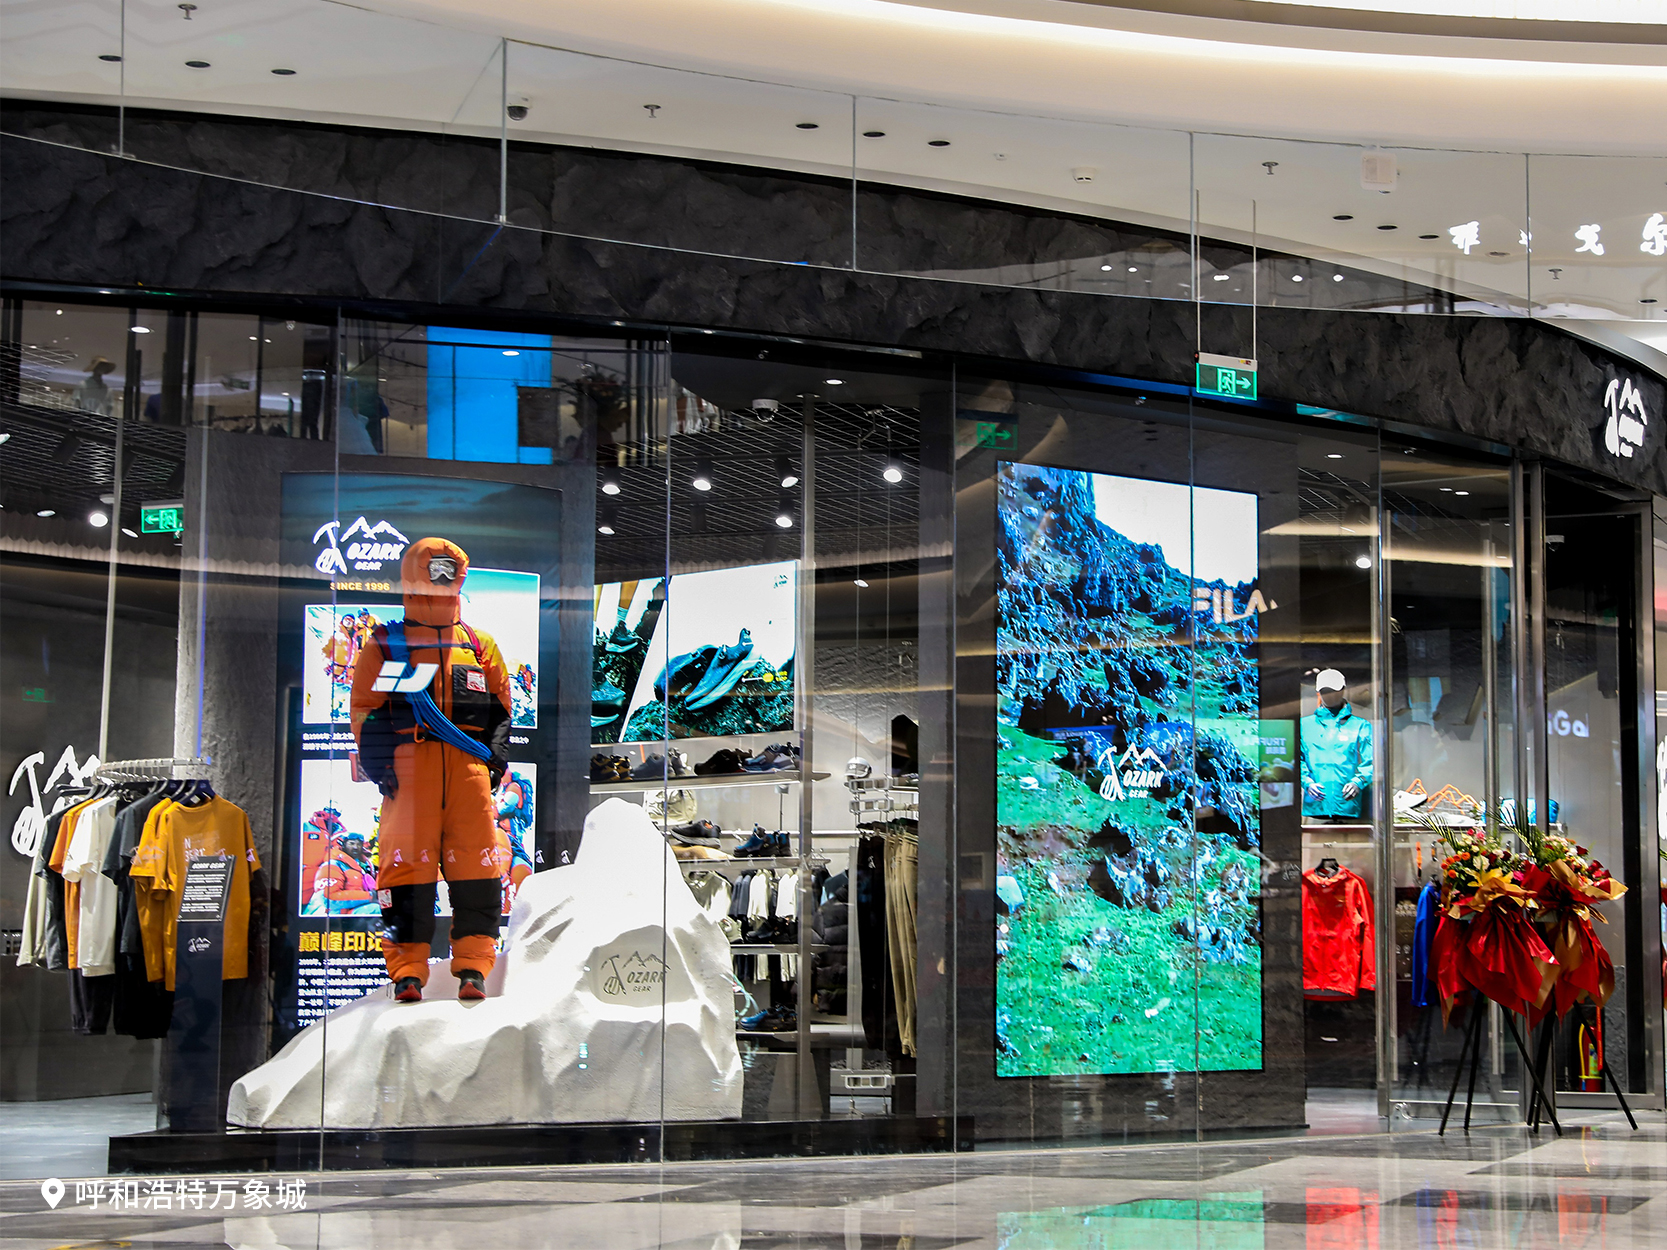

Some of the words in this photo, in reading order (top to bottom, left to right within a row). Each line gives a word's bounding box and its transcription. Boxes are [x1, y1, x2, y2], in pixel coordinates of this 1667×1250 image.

[347, 542, 405, 561] OZARK
[330, 581, 362, 591] SINCE
[364, 582, 390, 591] 1996
[1123, 769, 1164, 788] OZARK
[1128, 789, 1149, 799] GEAR
[298, 931, 384, 952] 巅峰印记
[626, 971, 668, 984] OZARK
